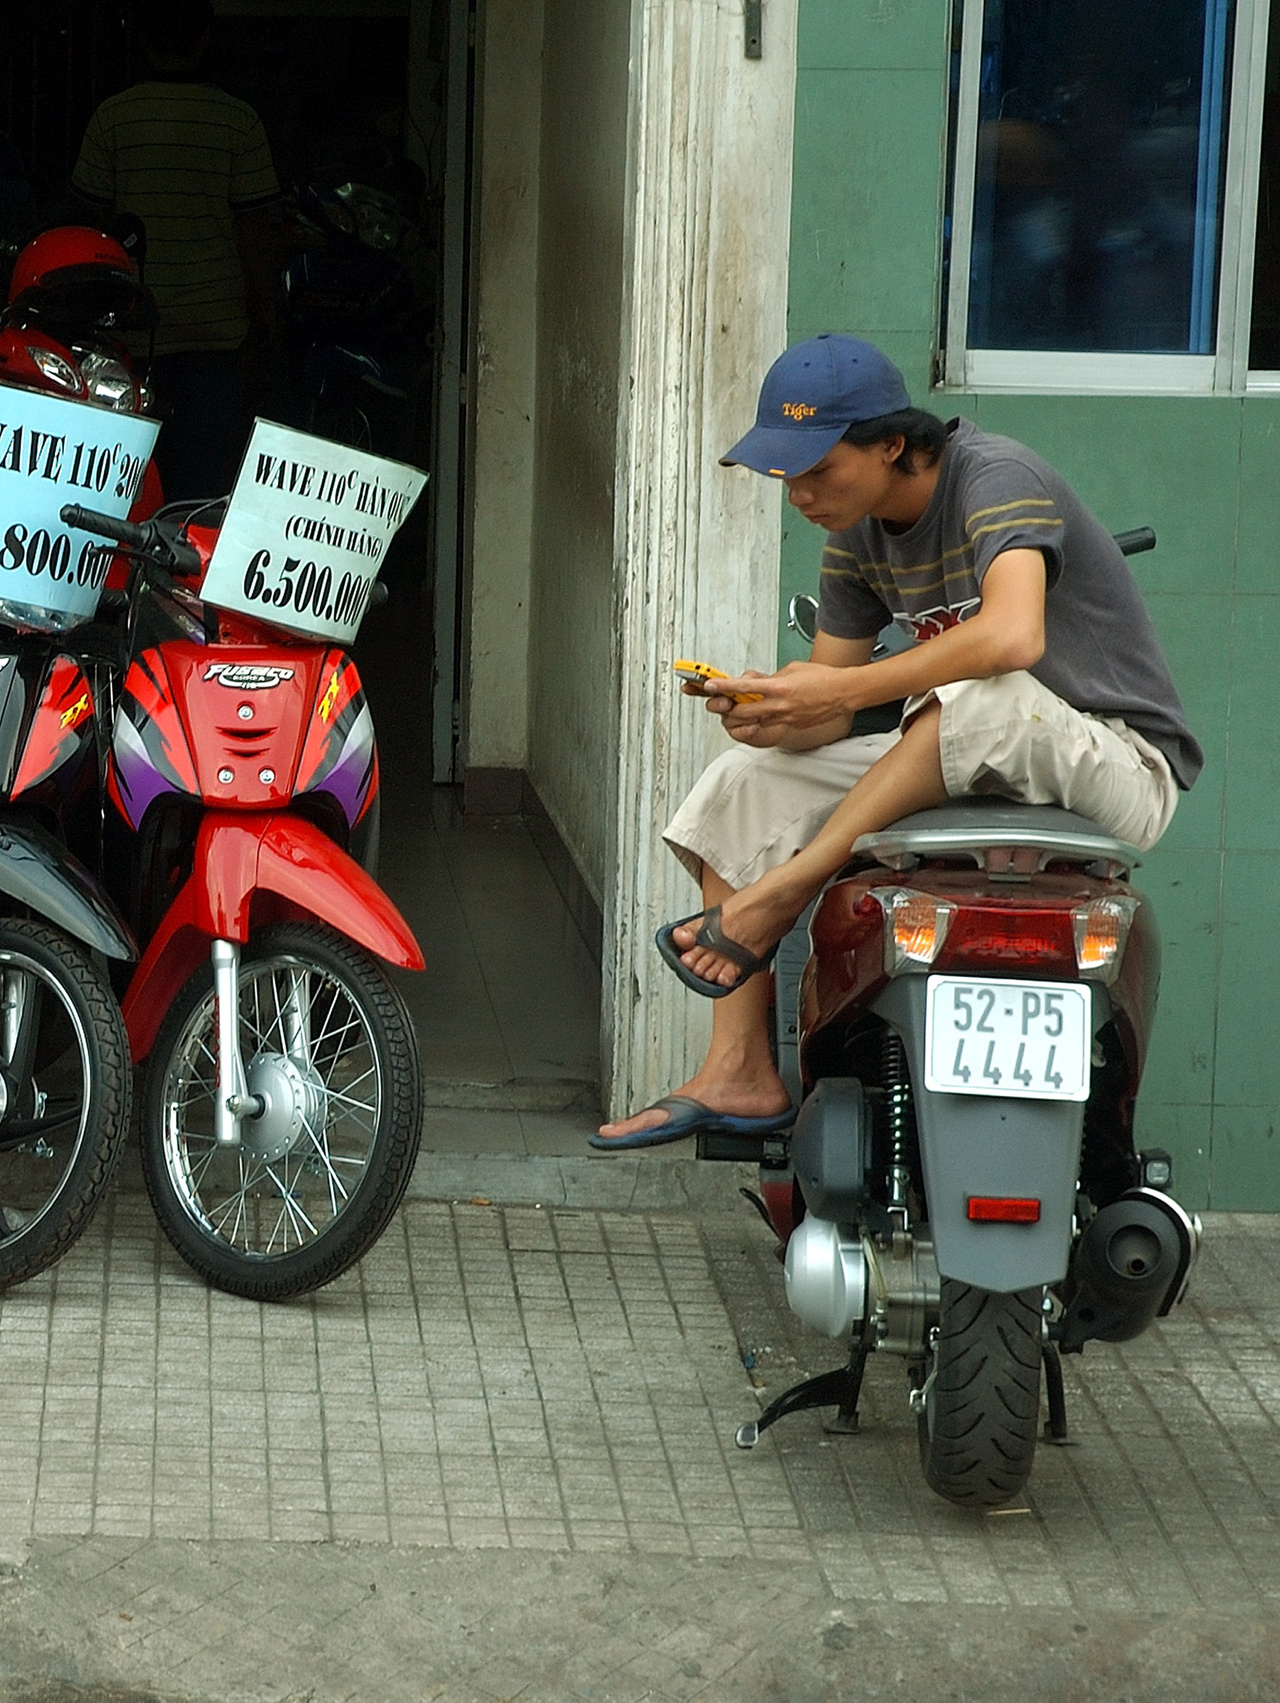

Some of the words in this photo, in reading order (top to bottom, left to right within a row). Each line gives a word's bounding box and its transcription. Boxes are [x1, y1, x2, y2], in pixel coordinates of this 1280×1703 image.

[782, 403, 817, 421] Tiger
[255, 452, 317, 497] WAVE
[285, 515, 345, 551] (CHÍNH
[243, 549, 370, 627] 6.500.000
[952, 1038, 1064, 1089] 4444
